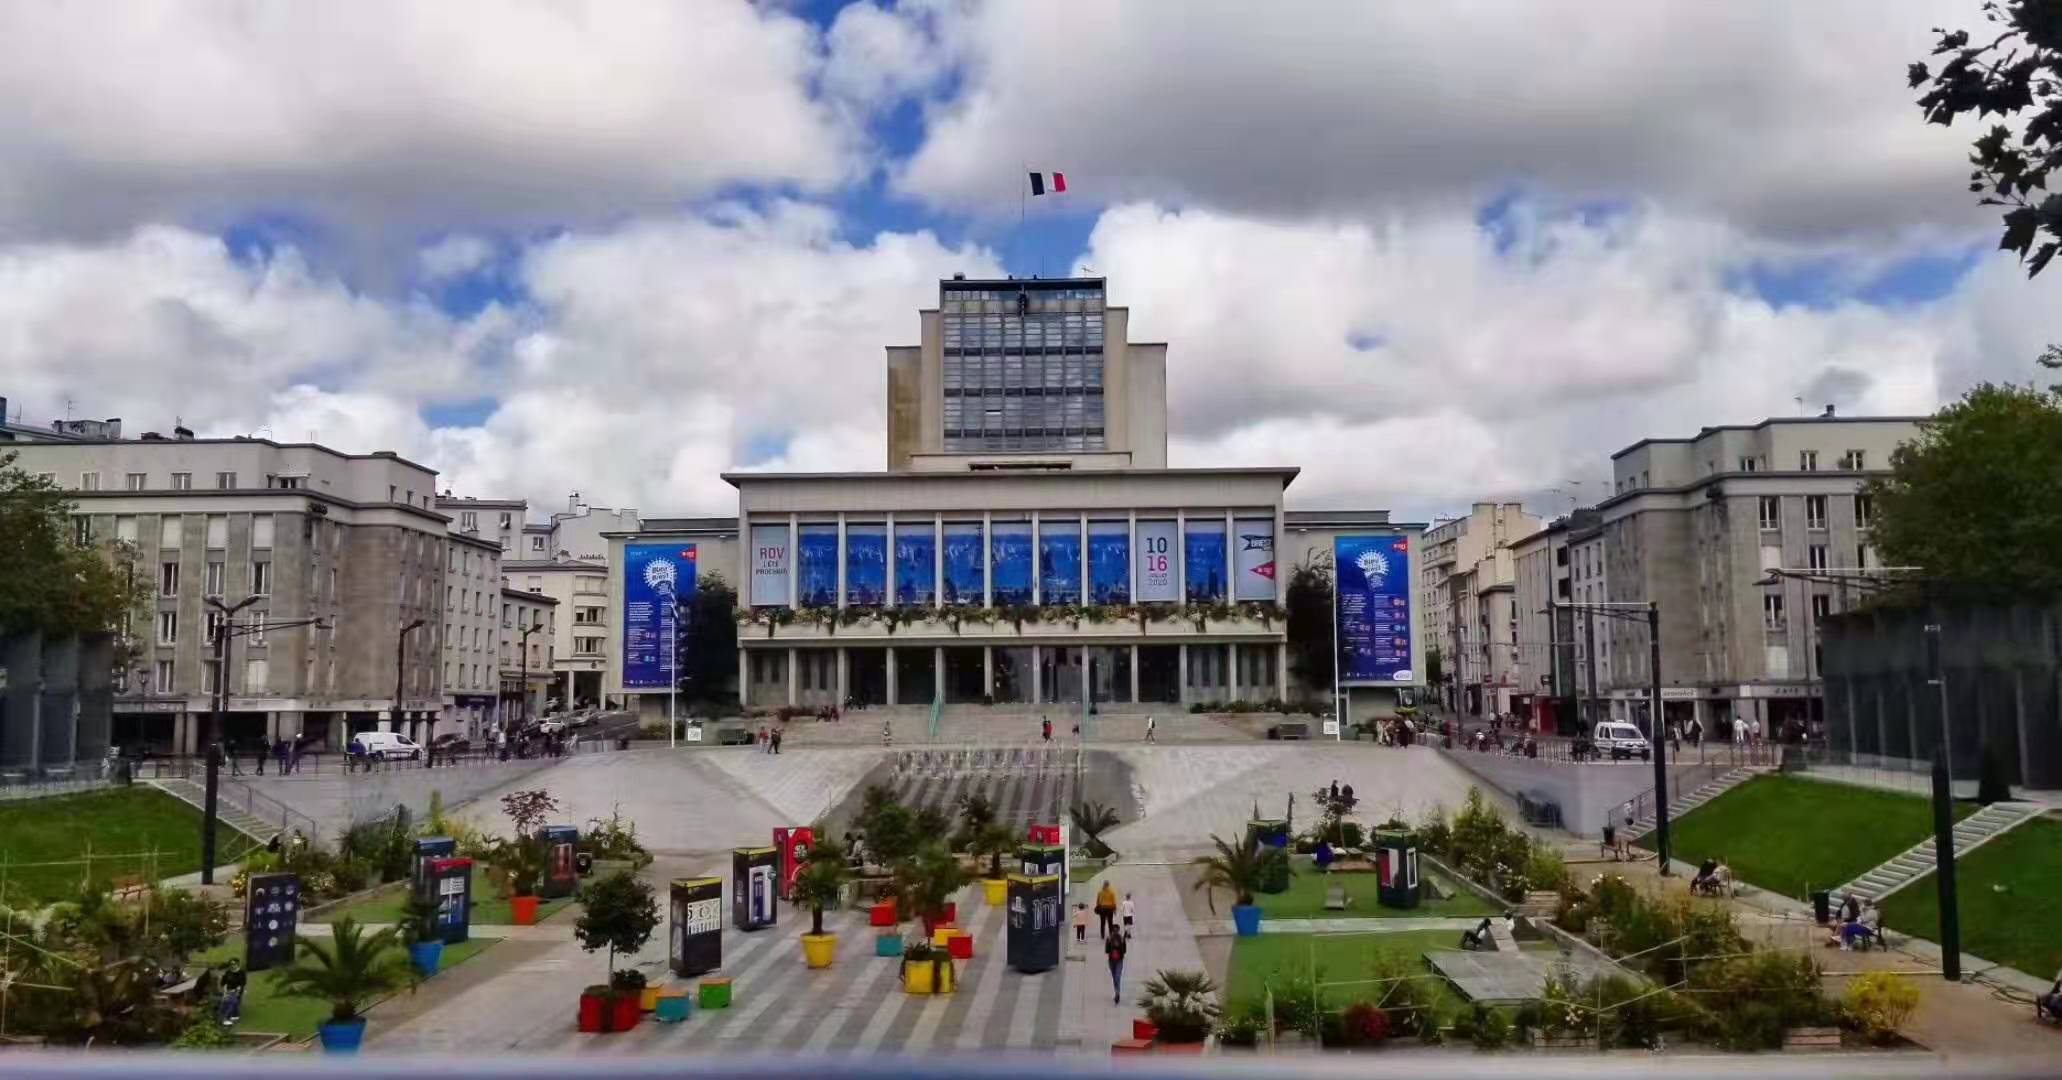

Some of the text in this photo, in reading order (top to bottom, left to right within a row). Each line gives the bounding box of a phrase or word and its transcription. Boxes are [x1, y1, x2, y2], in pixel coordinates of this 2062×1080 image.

[760, 547, 785, 559] RDV
[1146, 537, 1167, 553] 10
[1147, 555, 1167, 571] 16
